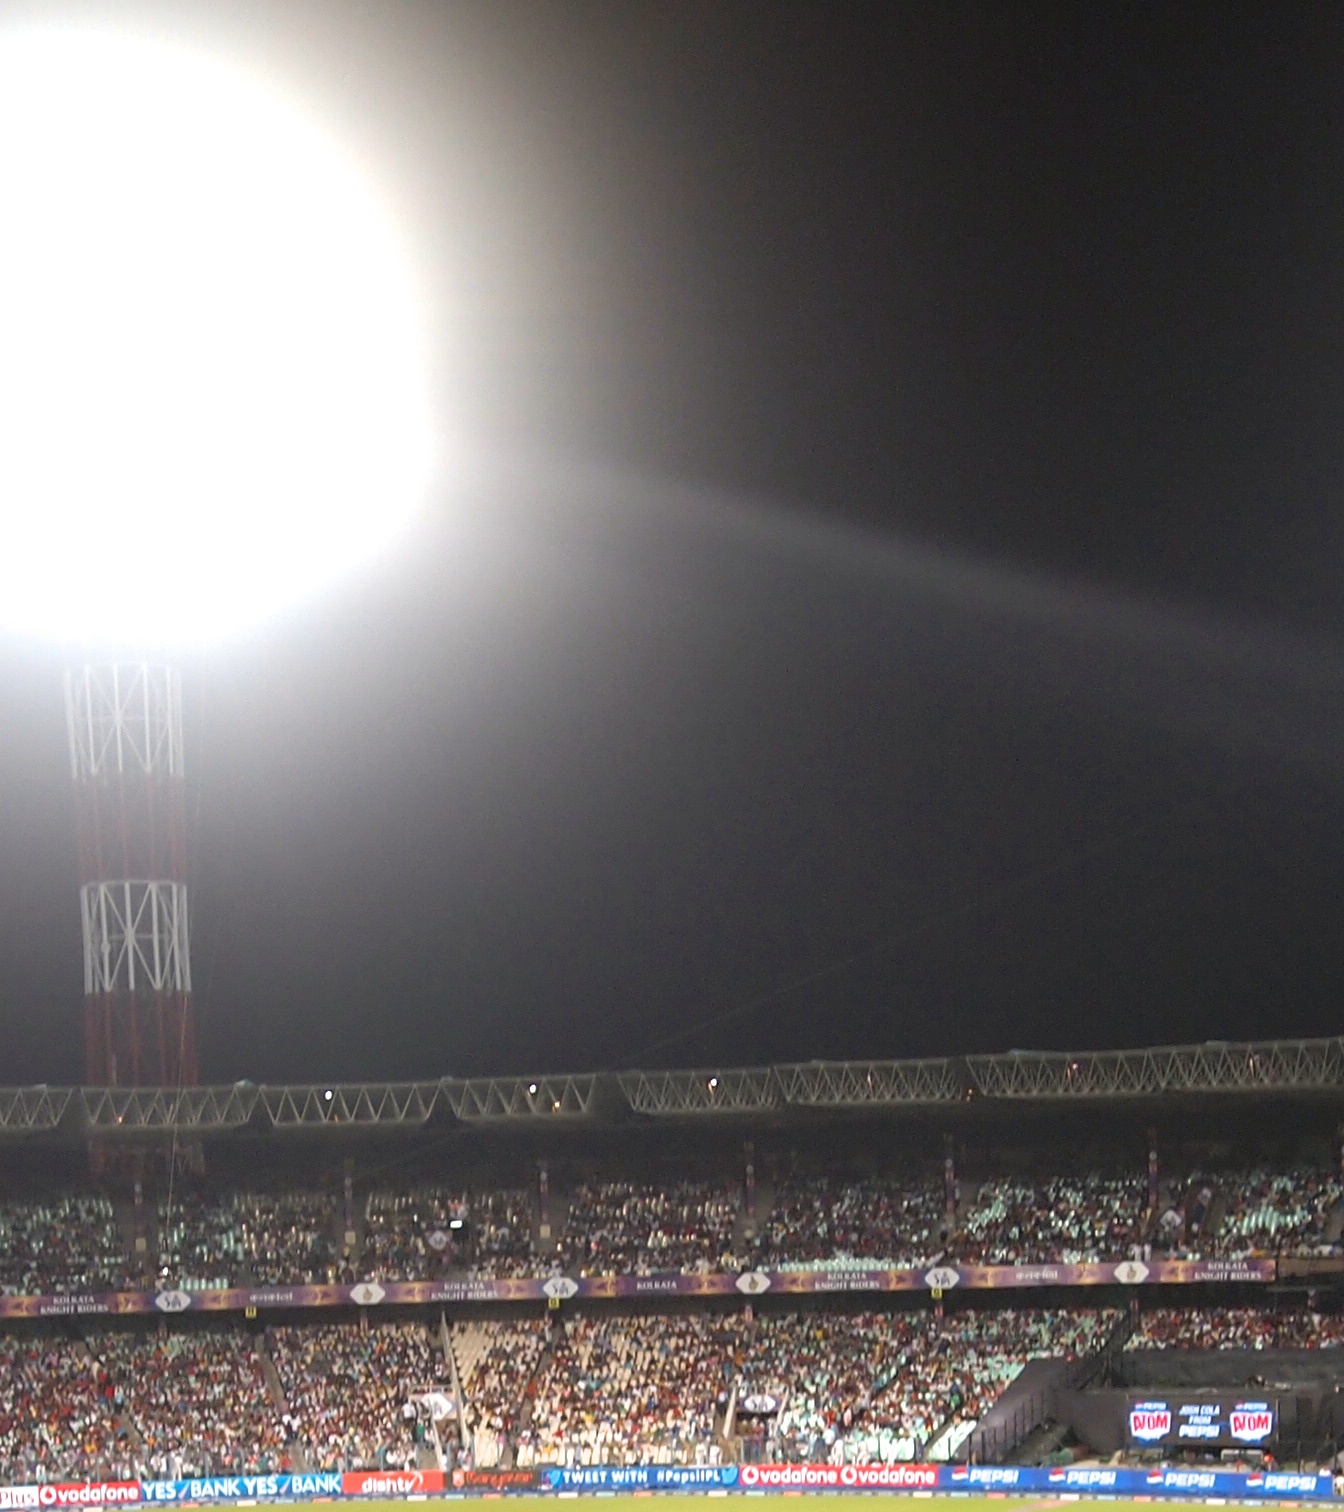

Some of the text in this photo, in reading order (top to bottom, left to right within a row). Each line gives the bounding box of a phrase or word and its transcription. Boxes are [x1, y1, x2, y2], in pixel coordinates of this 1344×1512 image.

[244, 1475, 342, 1495] YES BANK
[562, 1470, 607, 1484] TWEET
[612, 1469, 648, 1483] WITH
[760, 1469, 837, 1486] vodafone
[857, 1467, 937, 1486] vodafone
[969, 1470, 1019, 1485] PEPSI
[1066, 1471, 1117, 1486] PEPSI
[1164, 1472, 1216, 1488] PEPSI
[1264, 1475, 1317, 1492] PEPSI
[57, 1481, 139, 1503] vodafone
[143, 1479, 238, 1499] YES BANK
